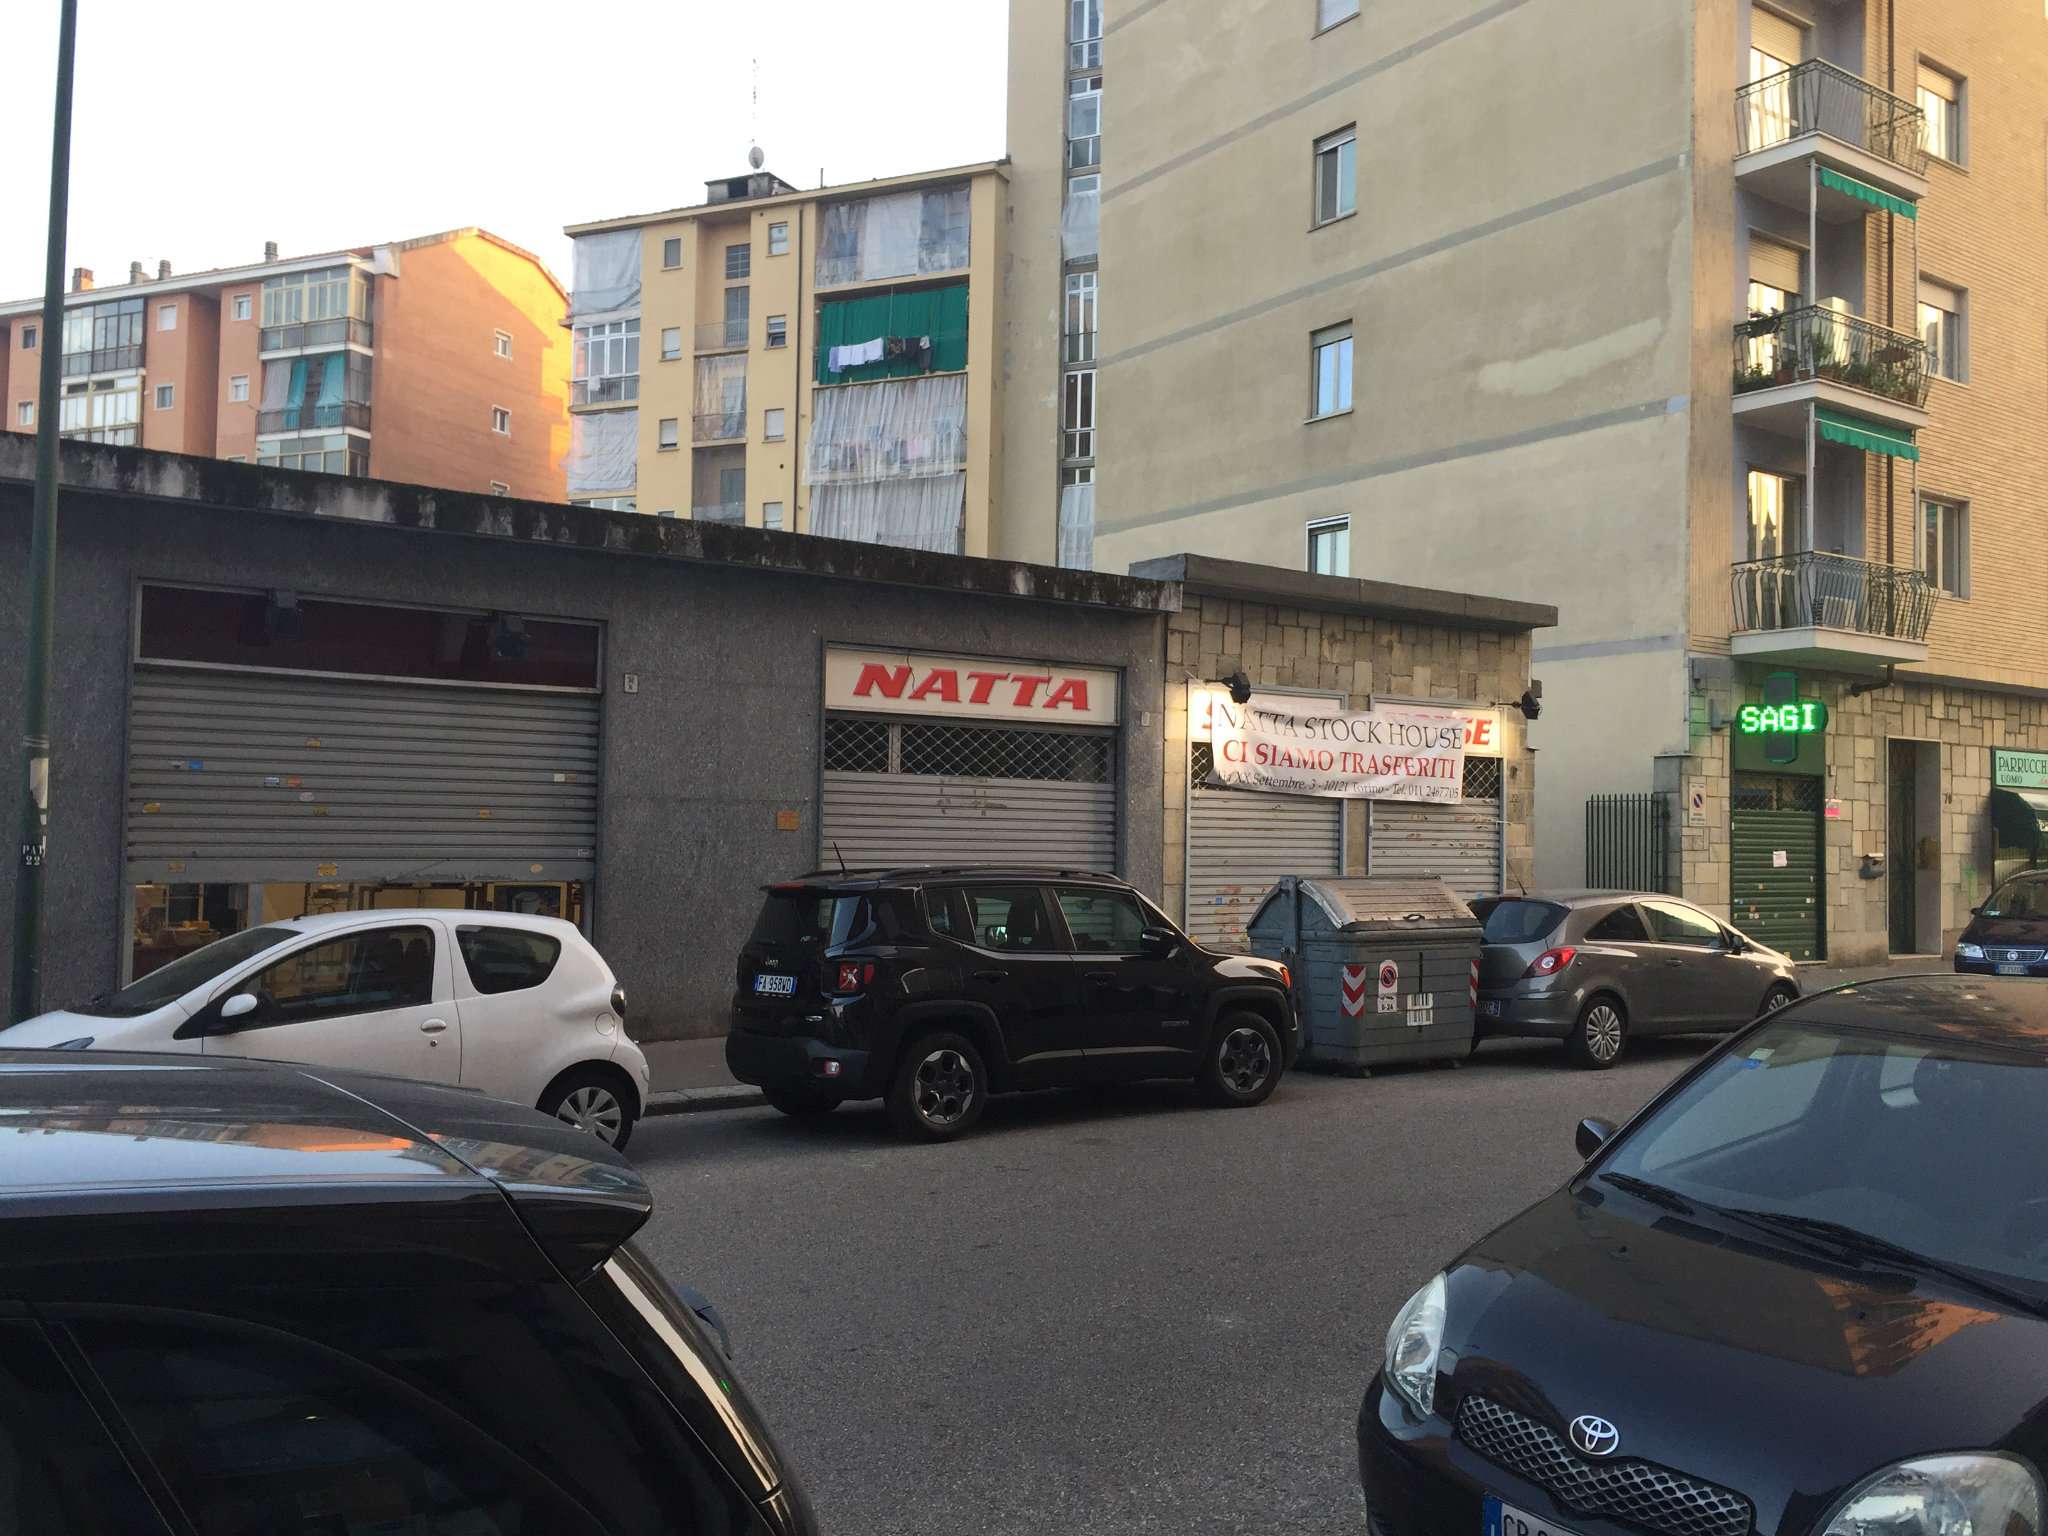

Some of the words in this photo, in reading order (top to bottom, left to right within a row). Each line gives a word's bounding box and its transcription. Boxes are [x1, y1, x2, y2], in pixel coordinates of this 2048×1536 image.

[852, 662, 1092, 711] NATTA
[1218, 703, 1299, 737] NATTA
[1305, 716, 1382, 744] STOCK
[1389, 723, 1463, 749] HOUSE
[1740, 703, 1817, 733] SAGI
[1223, 739, 1248, 762] CI
[1255, 743, 1333, 771] SIAMO
[1340, 751, 1456, 779] TRASFERITI
[1323, 780, 1349, 792] 10121
[2001, 774, 2023, 784] UOMO
